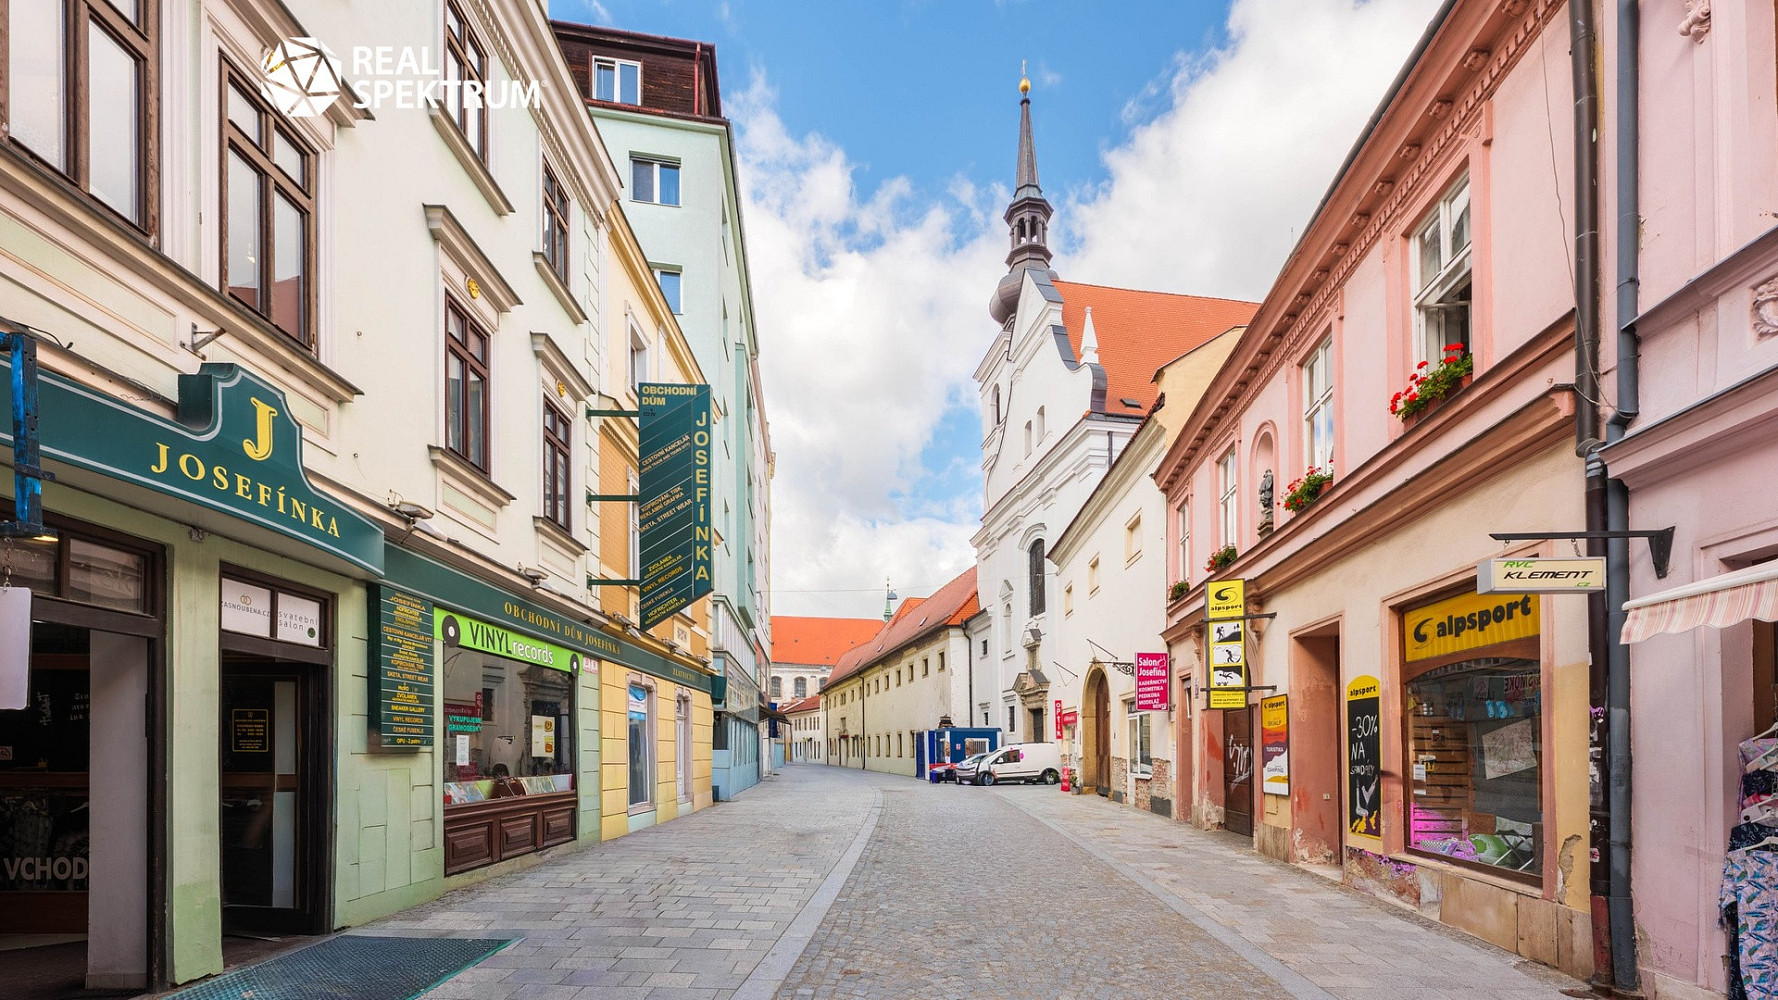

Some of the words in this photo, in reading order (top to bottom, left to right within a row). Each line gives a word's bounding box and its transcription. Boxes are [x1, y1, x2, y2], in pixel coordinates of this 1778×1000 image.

[642, 385, 697, 396] OBCHODNÍ
[642, 395, 666, 406] DŮM
[243, 397, 277, 461] J
[151, 442, 340, 538] JOSEFÍNKA
[1503, 560, 1537, 569] RVC
[1503, 570, 1593, 580] KLEMENT
[642, 581, 658, 593] VINYL
[657, 565, 684, 583] RECORDS
[278, 619, 304, 631] salon
[1436, 594, 1532, 638] alpsport
[504, 601, 560, 633] OBCHODNÍ
[564, 624, 582, 641] DŮM
[584, 633, 622, 655] JOSEFÍNKA
[469, 621, 512, 654] VINYL
[512, 641, 554, 665] records
[1138, 657, 1159, 667] Salon
[1350, 685, 1377, 697] alpsport
[1352, 714, 1378, 738] -30%
[1351, 741, 1366, 760] NA
[4, 857, 89, 881] VCHOD
